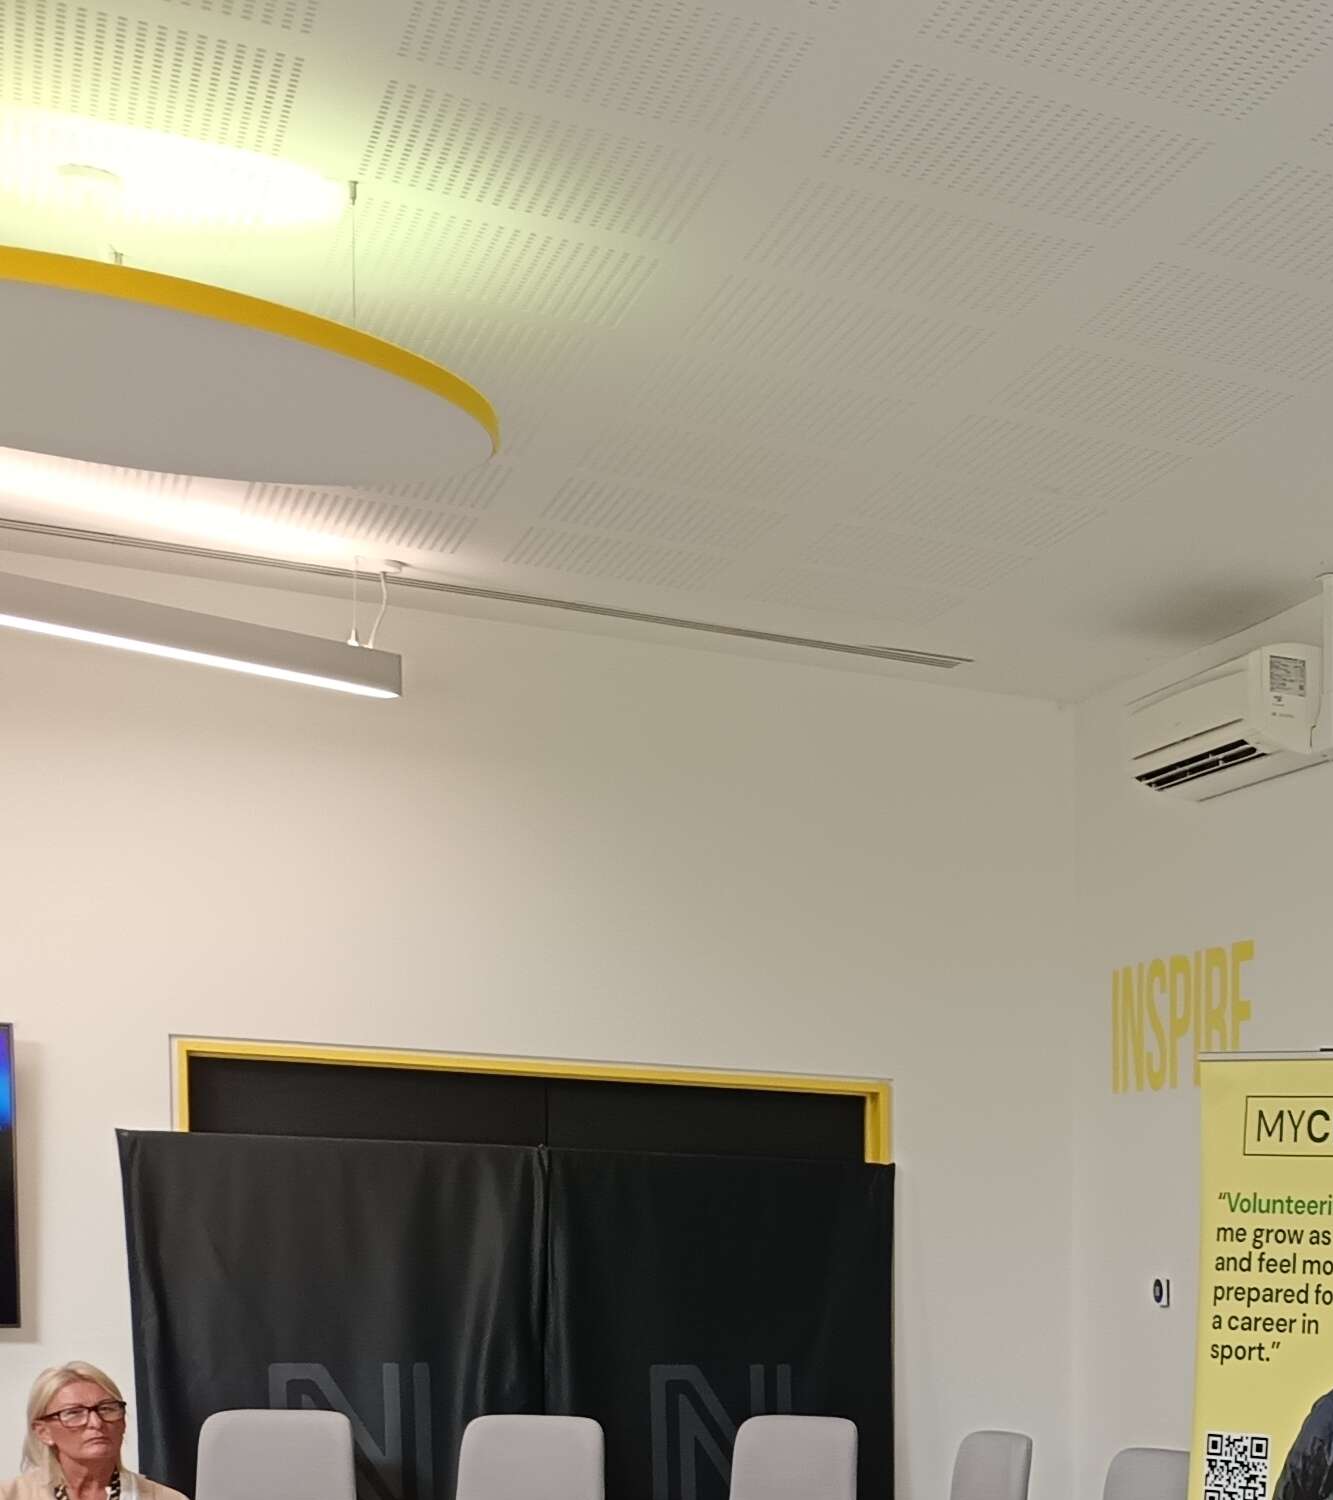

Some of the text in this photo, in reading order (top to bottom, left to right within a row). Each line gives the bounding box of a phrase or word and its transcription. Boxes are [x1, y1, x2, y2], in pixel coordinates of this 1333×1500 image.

[1216, 1226, 1247, 1243] me
[1252, 1226, 1305, 1249] grow
[1309, 1229, 1332, 1246] as
[1214, 1251, 1253, 1272] and
[1257, 1252, 1297, 1274] feel
[1213, 1284, 1309, 1307] prepared
[1211, 1314, 1320, 1335] a career in
[1210, 1341, 1281, 1365] sport."
